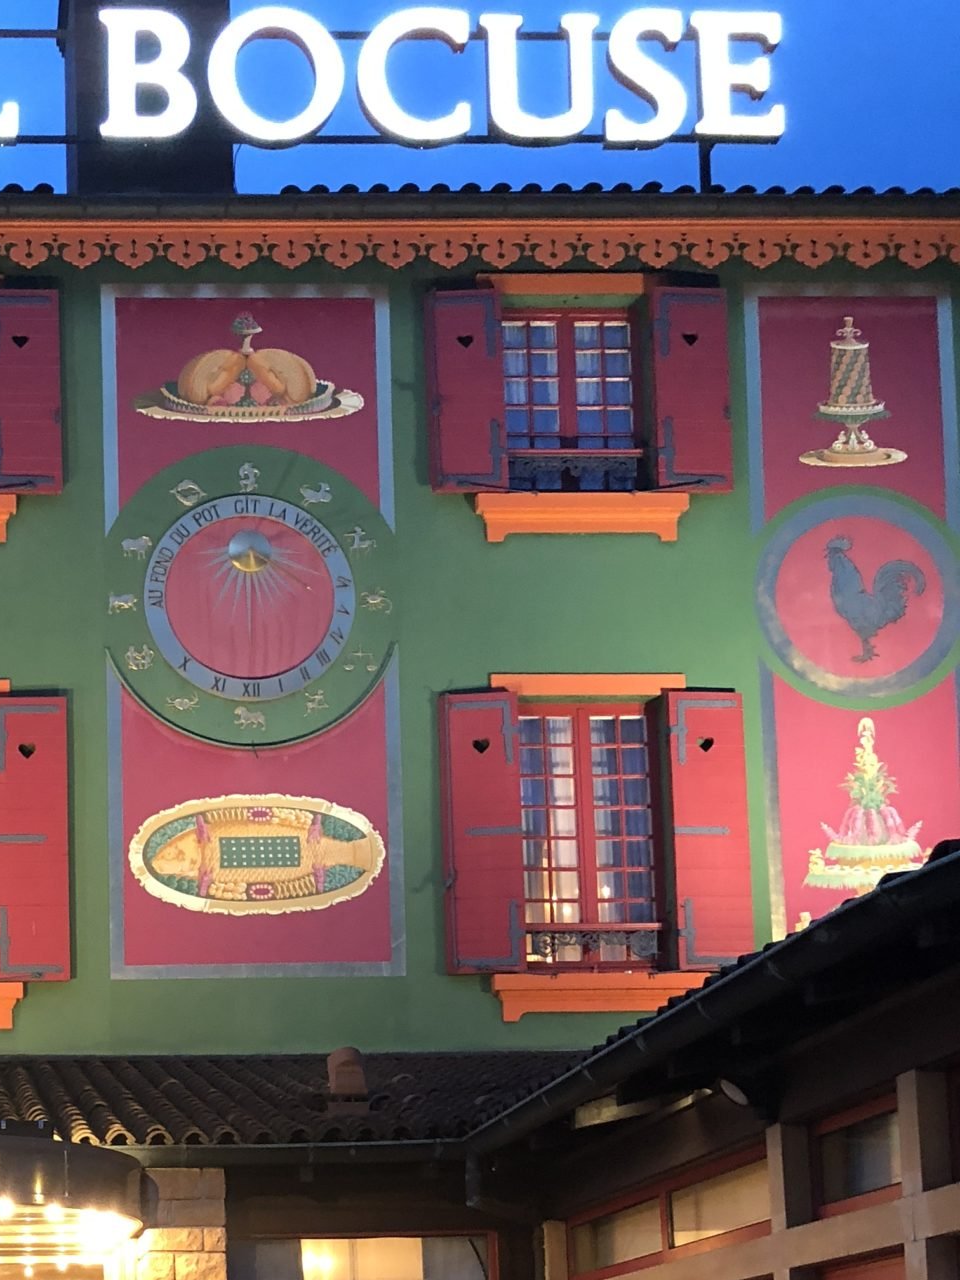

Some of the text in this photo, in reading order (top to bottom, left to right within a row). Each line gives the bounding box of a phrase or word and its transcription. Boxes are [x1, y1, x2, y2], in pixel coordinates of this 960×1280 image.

[97, 5, 786, 149] BOCUSE
[192, 504, 221, 527] POT
[268, 502, 287, 520] LA
[169, 524, 190, 544] DU
[150, 547, 174, 585] FOND
[148, 589, 165, 608] AU
[178, 656, 191, 672] X
[315, 649, 331, 667] III
[299, 667, 311, 682] II
[211, 676, 227, 692] XI
[242, 682, 261, 698] XII
